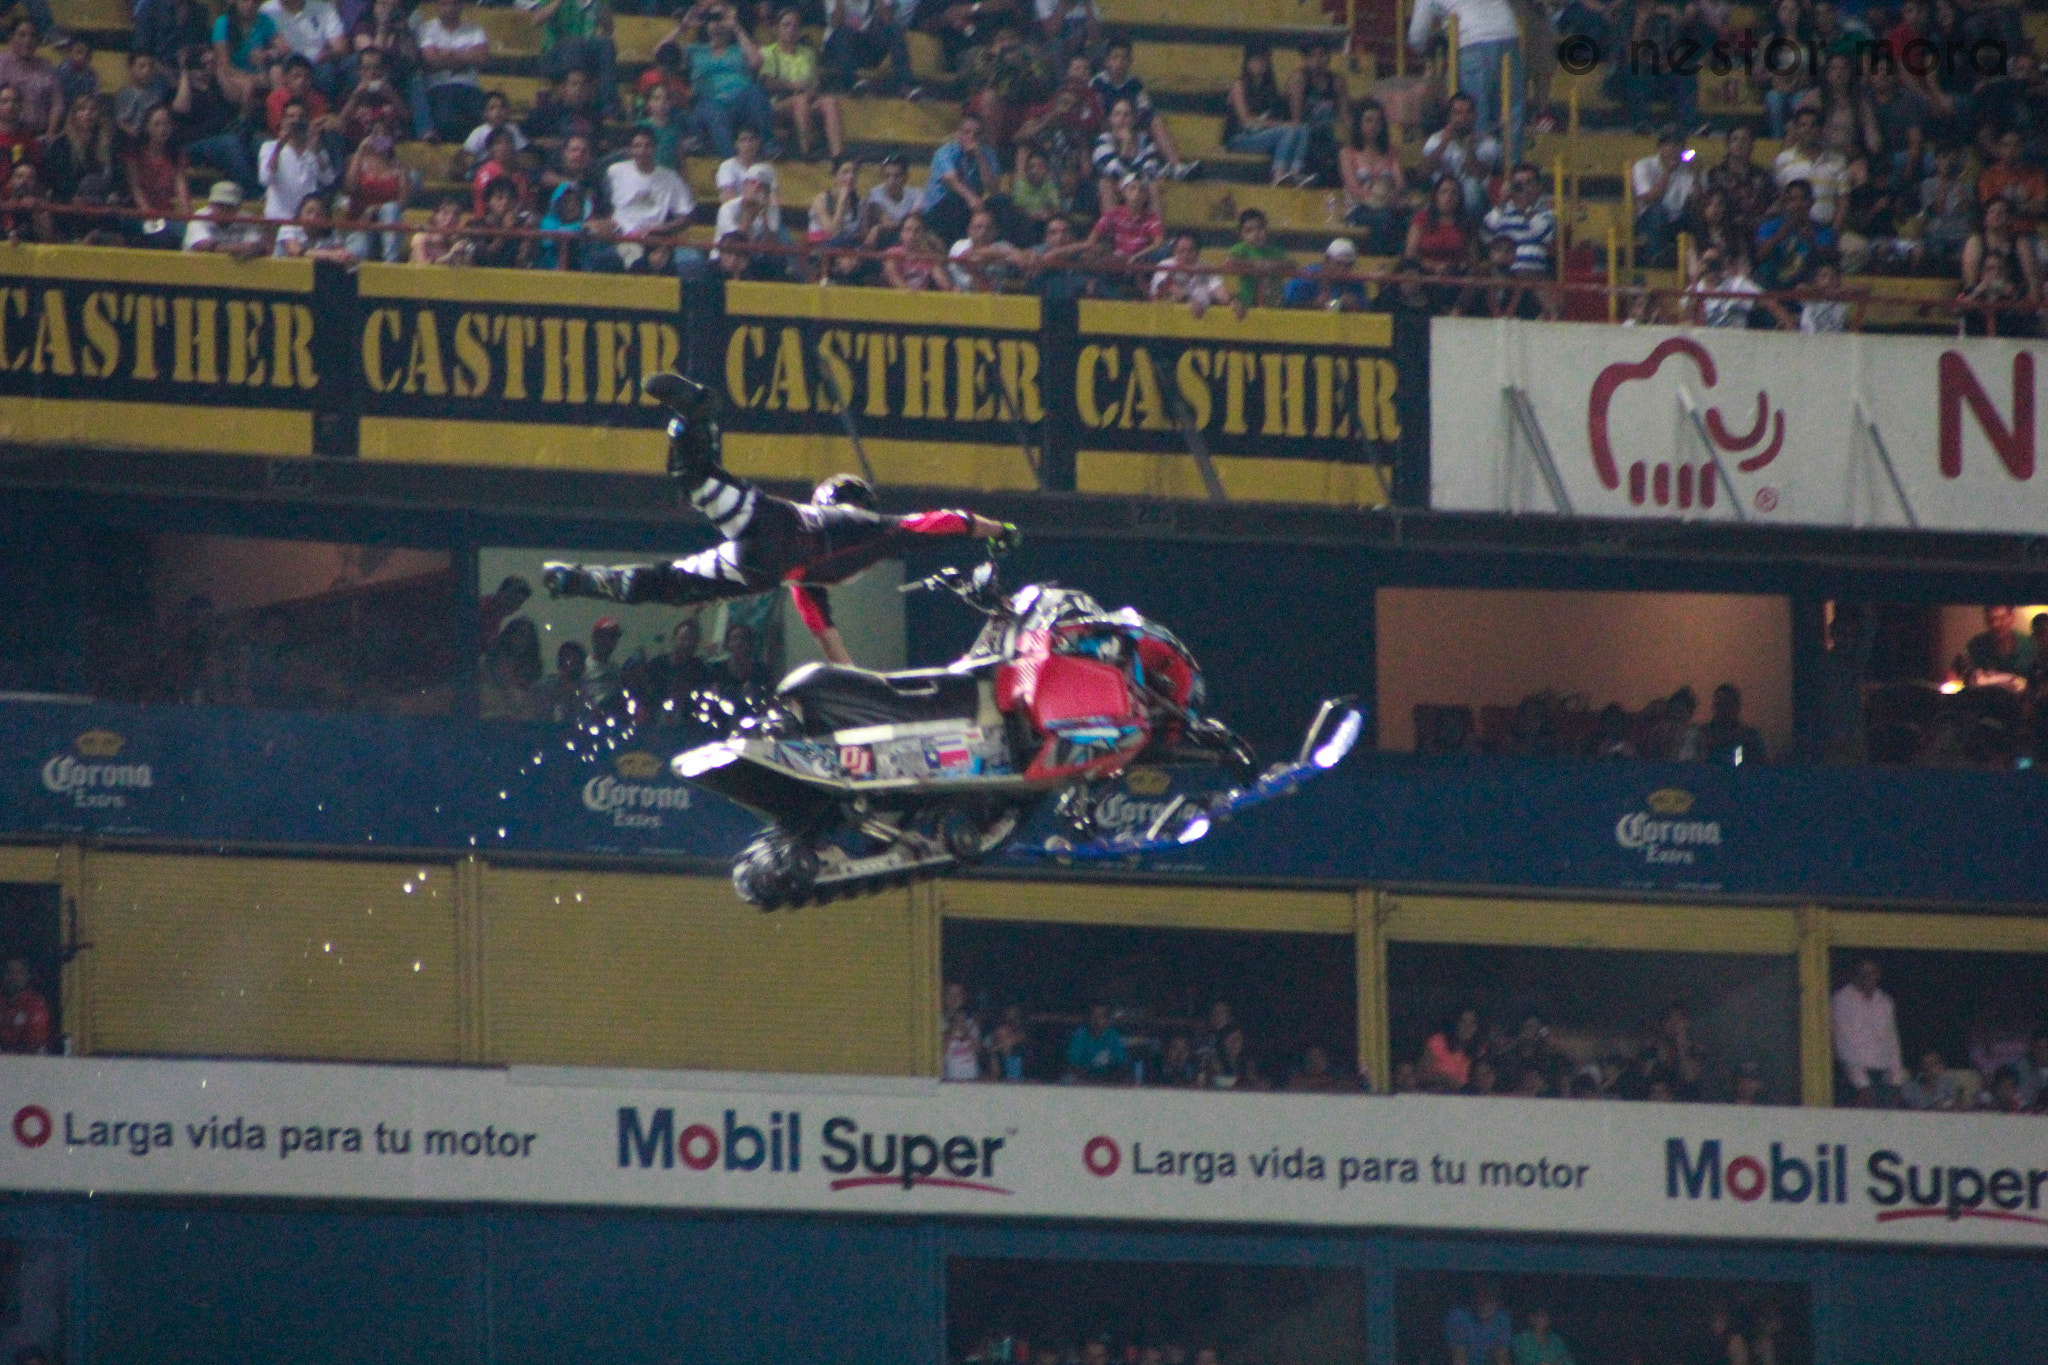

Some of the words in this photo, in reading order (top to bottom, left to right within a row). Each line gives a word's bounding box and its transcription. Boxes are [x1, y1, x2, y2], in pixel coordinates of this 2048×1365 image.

[0, 286, 319, 389] CASTHER
[361, 308, 681, 406] CASTHER
[726, 324, 1044, 423] CASTHER
[1075, 343, 1401, 442] CASTHER
[1938, 350, 2036, 481] N
[42, 755, 152, 793] Corona
[583, 775, 690, 811] Corona
[1616, 811, 1722, 848] Corona
[64, 1112, 173, 1156] Larga
[187, 1115, 266, 1149] vida
[280, 1125, 362, 1159] para
[376, 1122, 411, 1154] tu
[424, 1125, 538, 1156] motor
[617, 1106, 800, 1172] Mobil
[821, 1117, 1005, 1190] Super
[1133, 1142, 1236, 1184] Larga
[1250, 1146, 1325, 1180] vida
[1339, 1156, 1418, 1189] para
[1431, 1154, 1466, 1185] tu
[1479, 1158, 1590, 1188] motor
[1665, 1137, 1848, 1204] Mobil
[1867, 1149, 2048, 1222] Super
